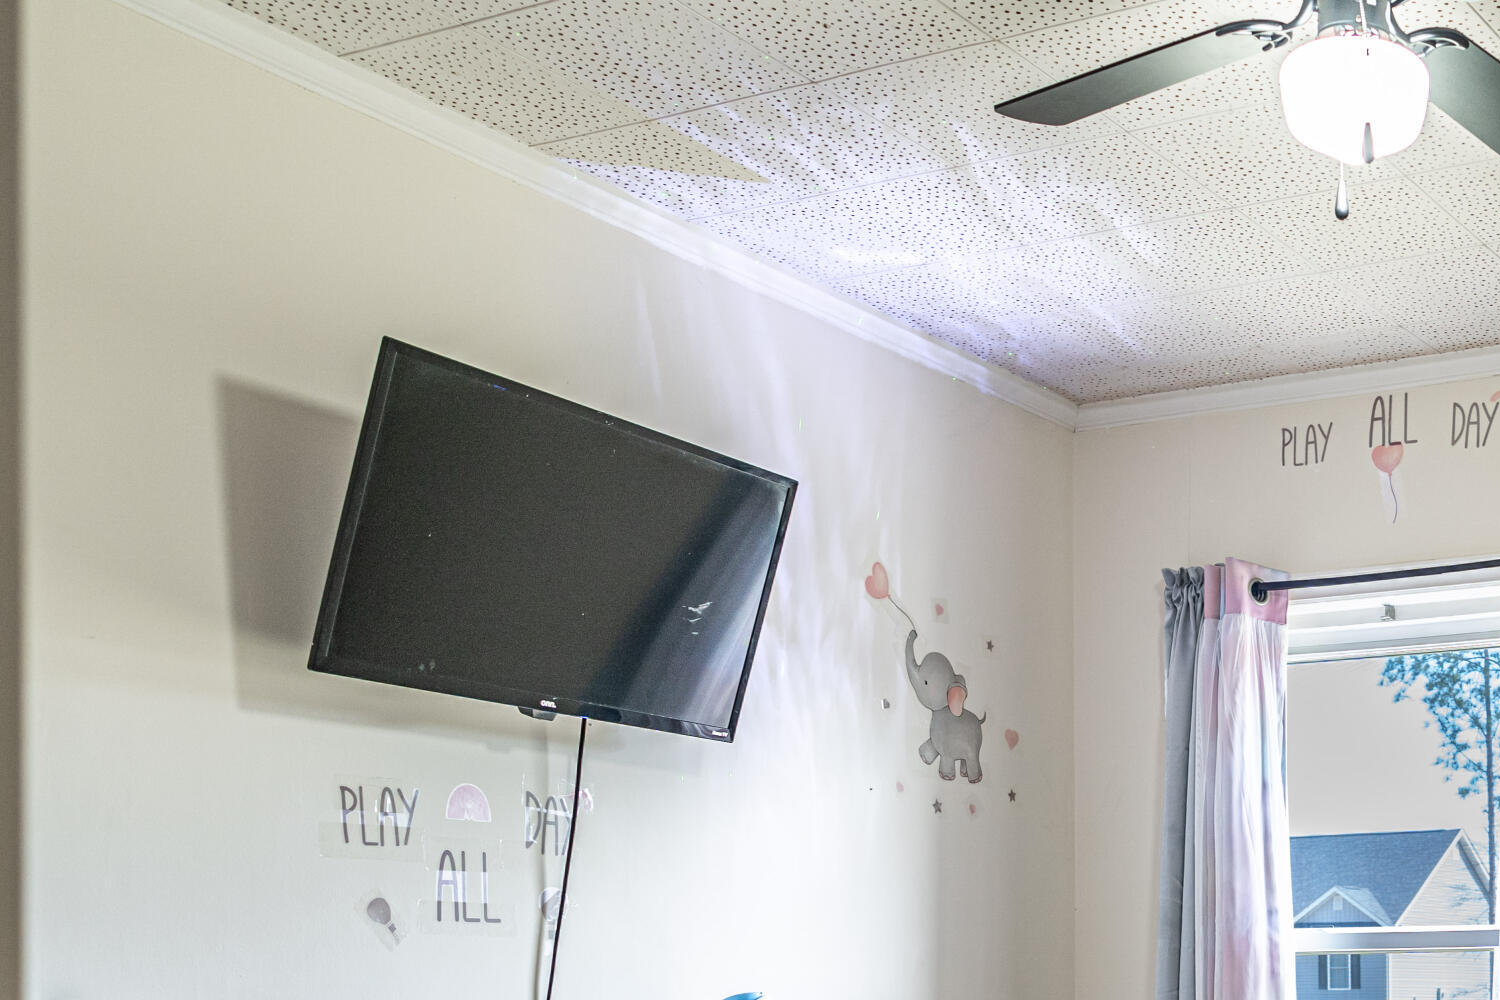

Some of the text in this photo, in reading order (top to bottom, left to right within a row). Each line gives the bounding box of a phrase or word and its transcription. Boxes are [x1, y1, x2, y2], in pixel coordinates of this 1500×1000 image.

[1281, 392, 1500, 466] PLAY ALL DAY
[340, 785, 572, 923] PLAY ALL DAY
